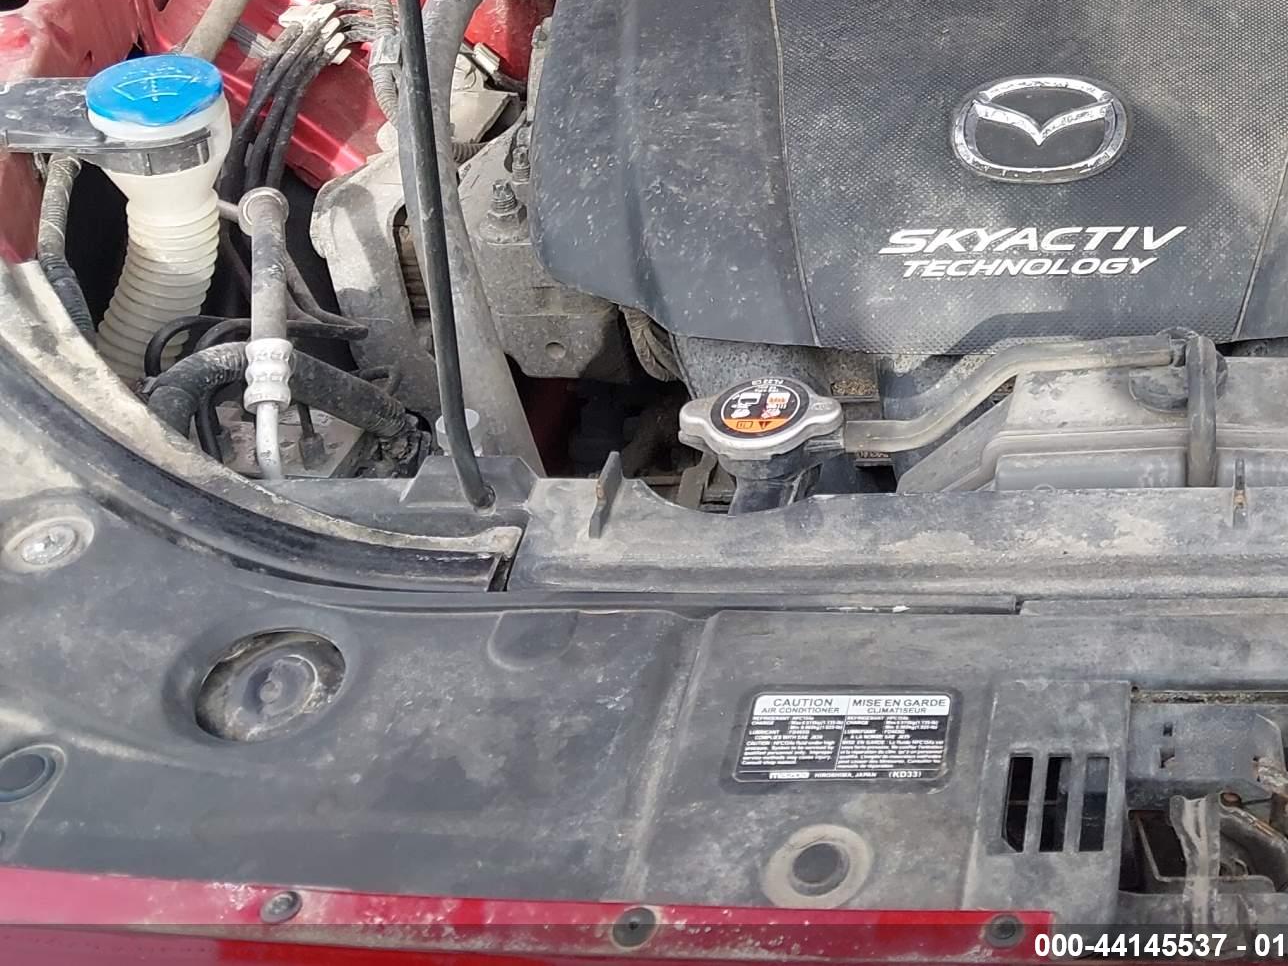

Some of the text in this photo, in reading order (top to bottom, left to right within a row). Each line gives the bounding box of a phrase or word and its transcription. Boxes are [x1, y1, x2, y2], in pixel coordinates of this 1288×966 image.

[878, 226, 1187, 254] SKYACTIV
[902, 258, 1157, 278] TECHNOLOGY
[773, 698, 833, 707] CAUTION
[852, 698, 946, 707] MISE EN GARDE
